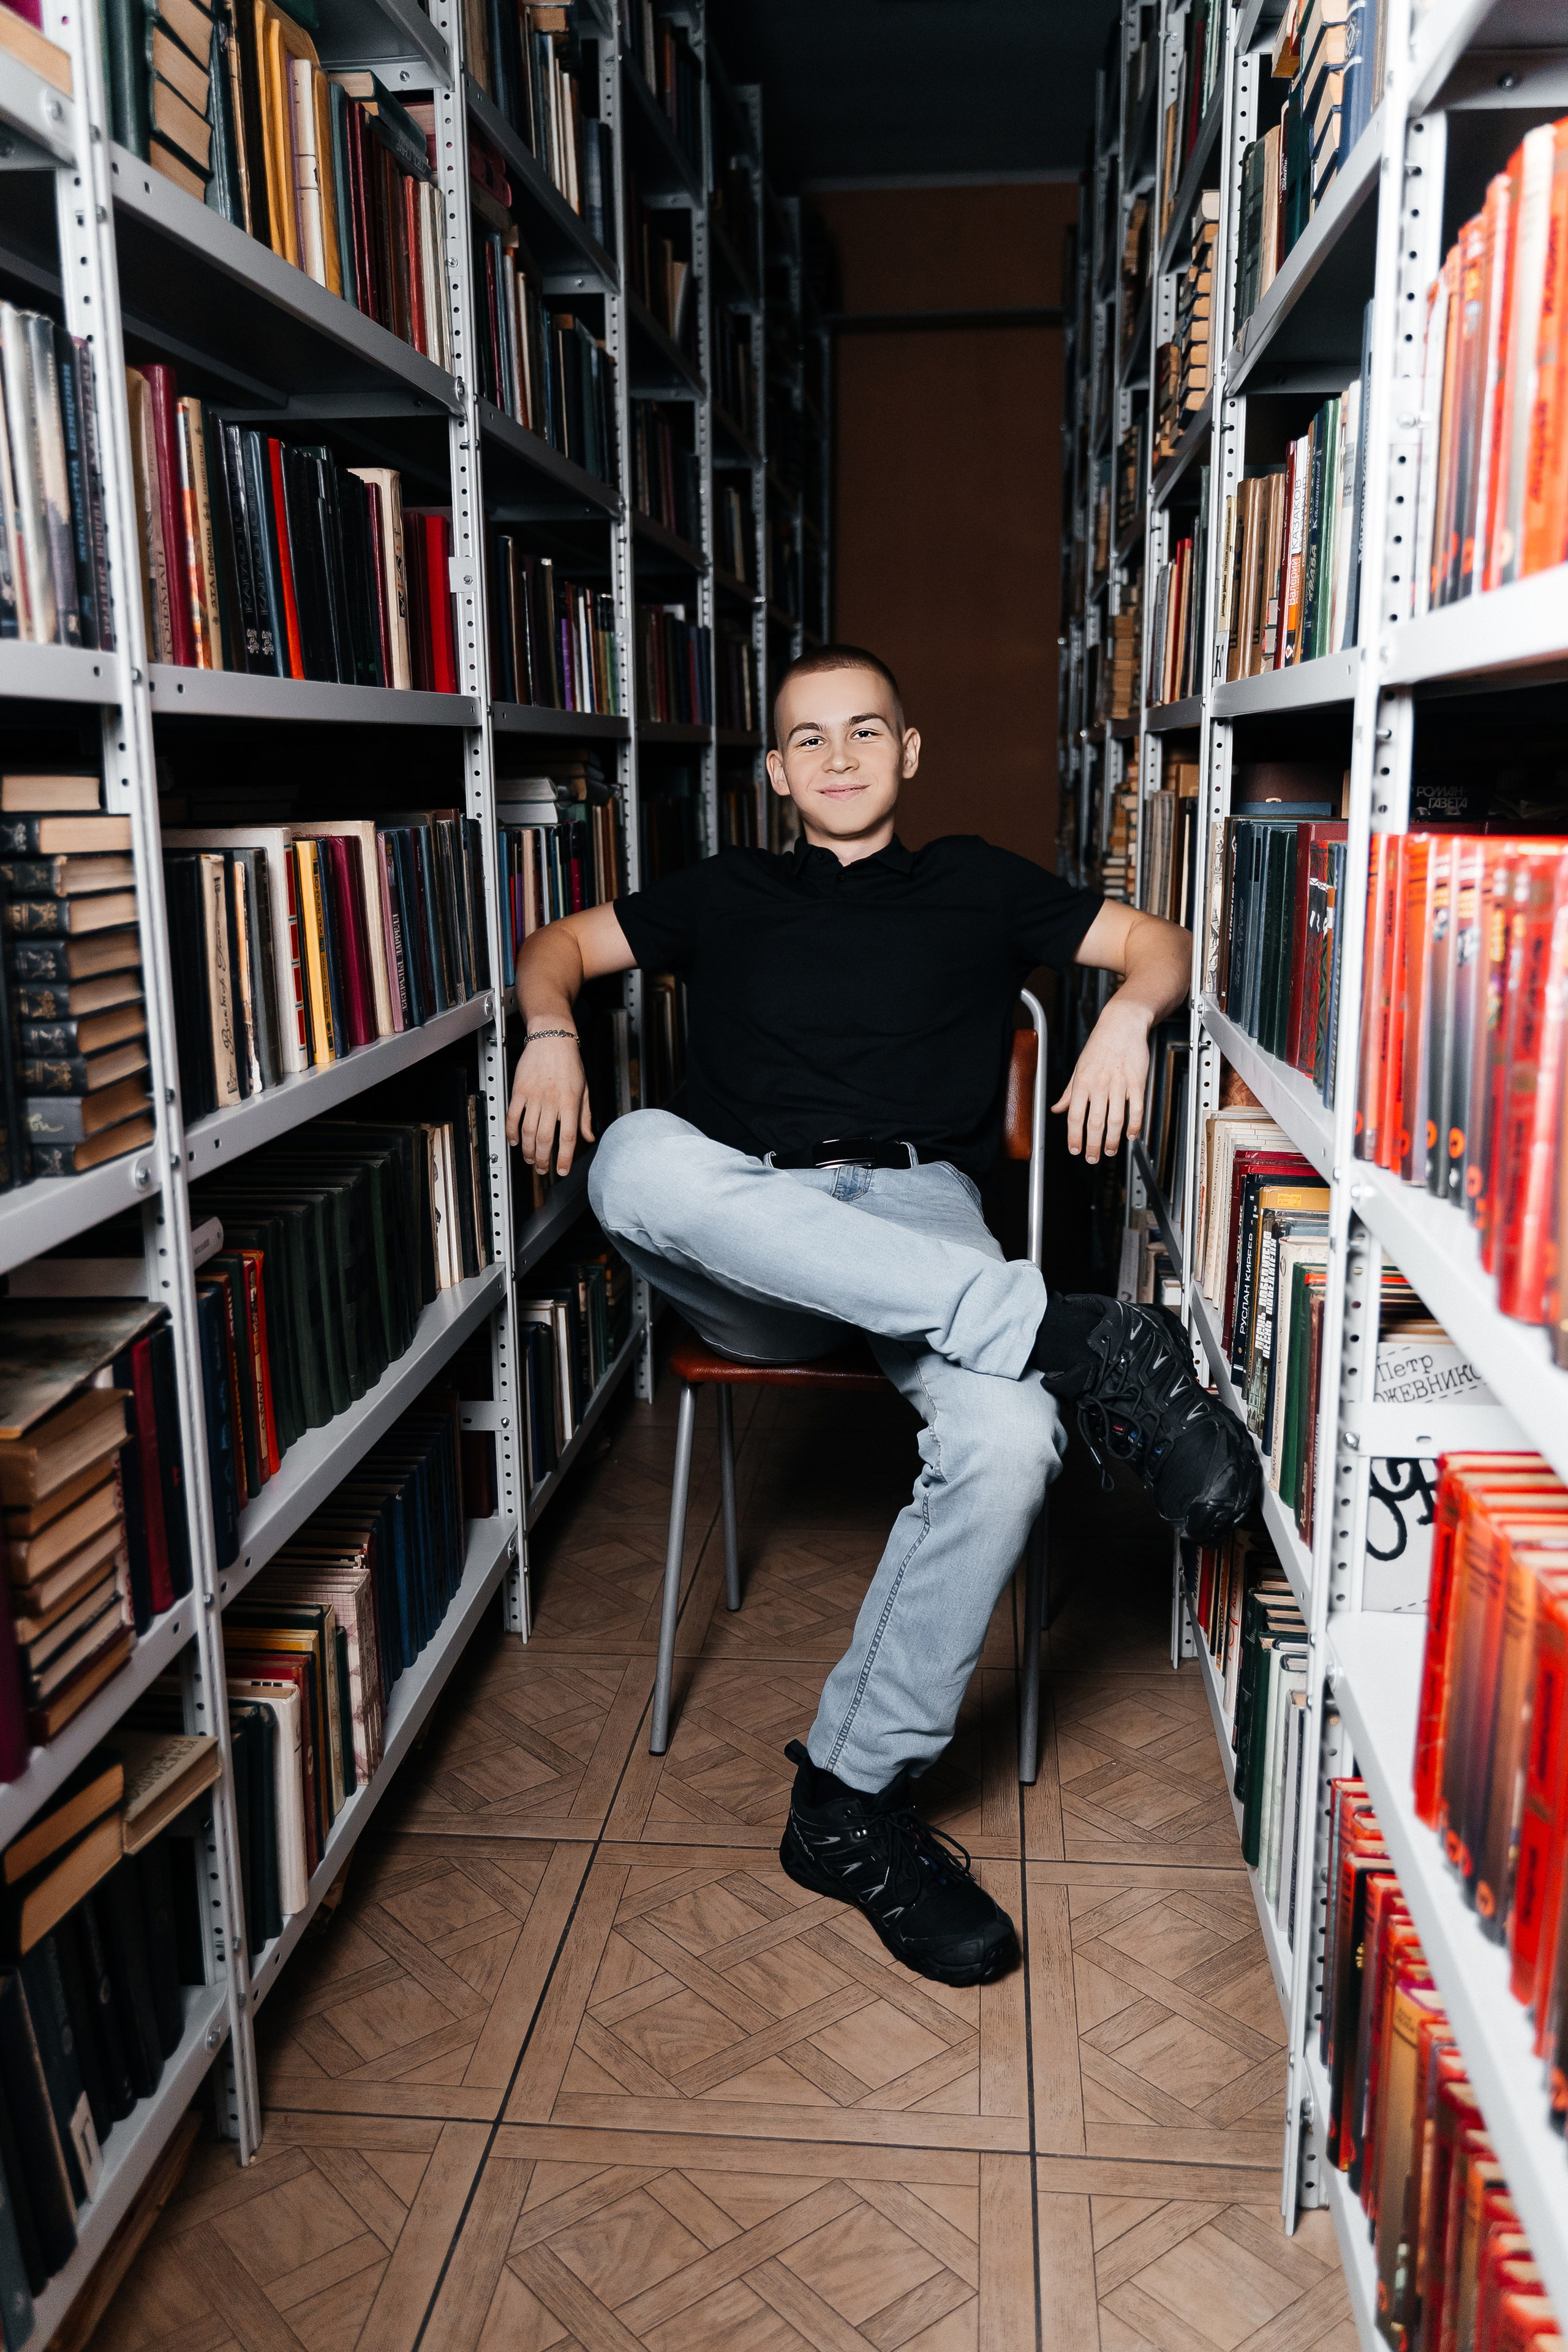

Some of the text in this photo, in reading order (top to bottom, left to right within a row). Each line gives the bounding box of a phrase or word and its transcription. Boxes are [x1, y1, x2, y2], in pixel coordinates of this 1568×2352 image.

[1291, 478, 1302, 549] КАЗАКОВ
[1416, 786, 1468, 797] РОМАН-
[1428, 797, 1468, 809] ГАЗЕТА
[1239, 1284, 1250, 1335] РУСЛАН
[1262, 1320, 1273, 1359] ПЕСНЬ
[1377, 1355, 1434, 1382] Петр
